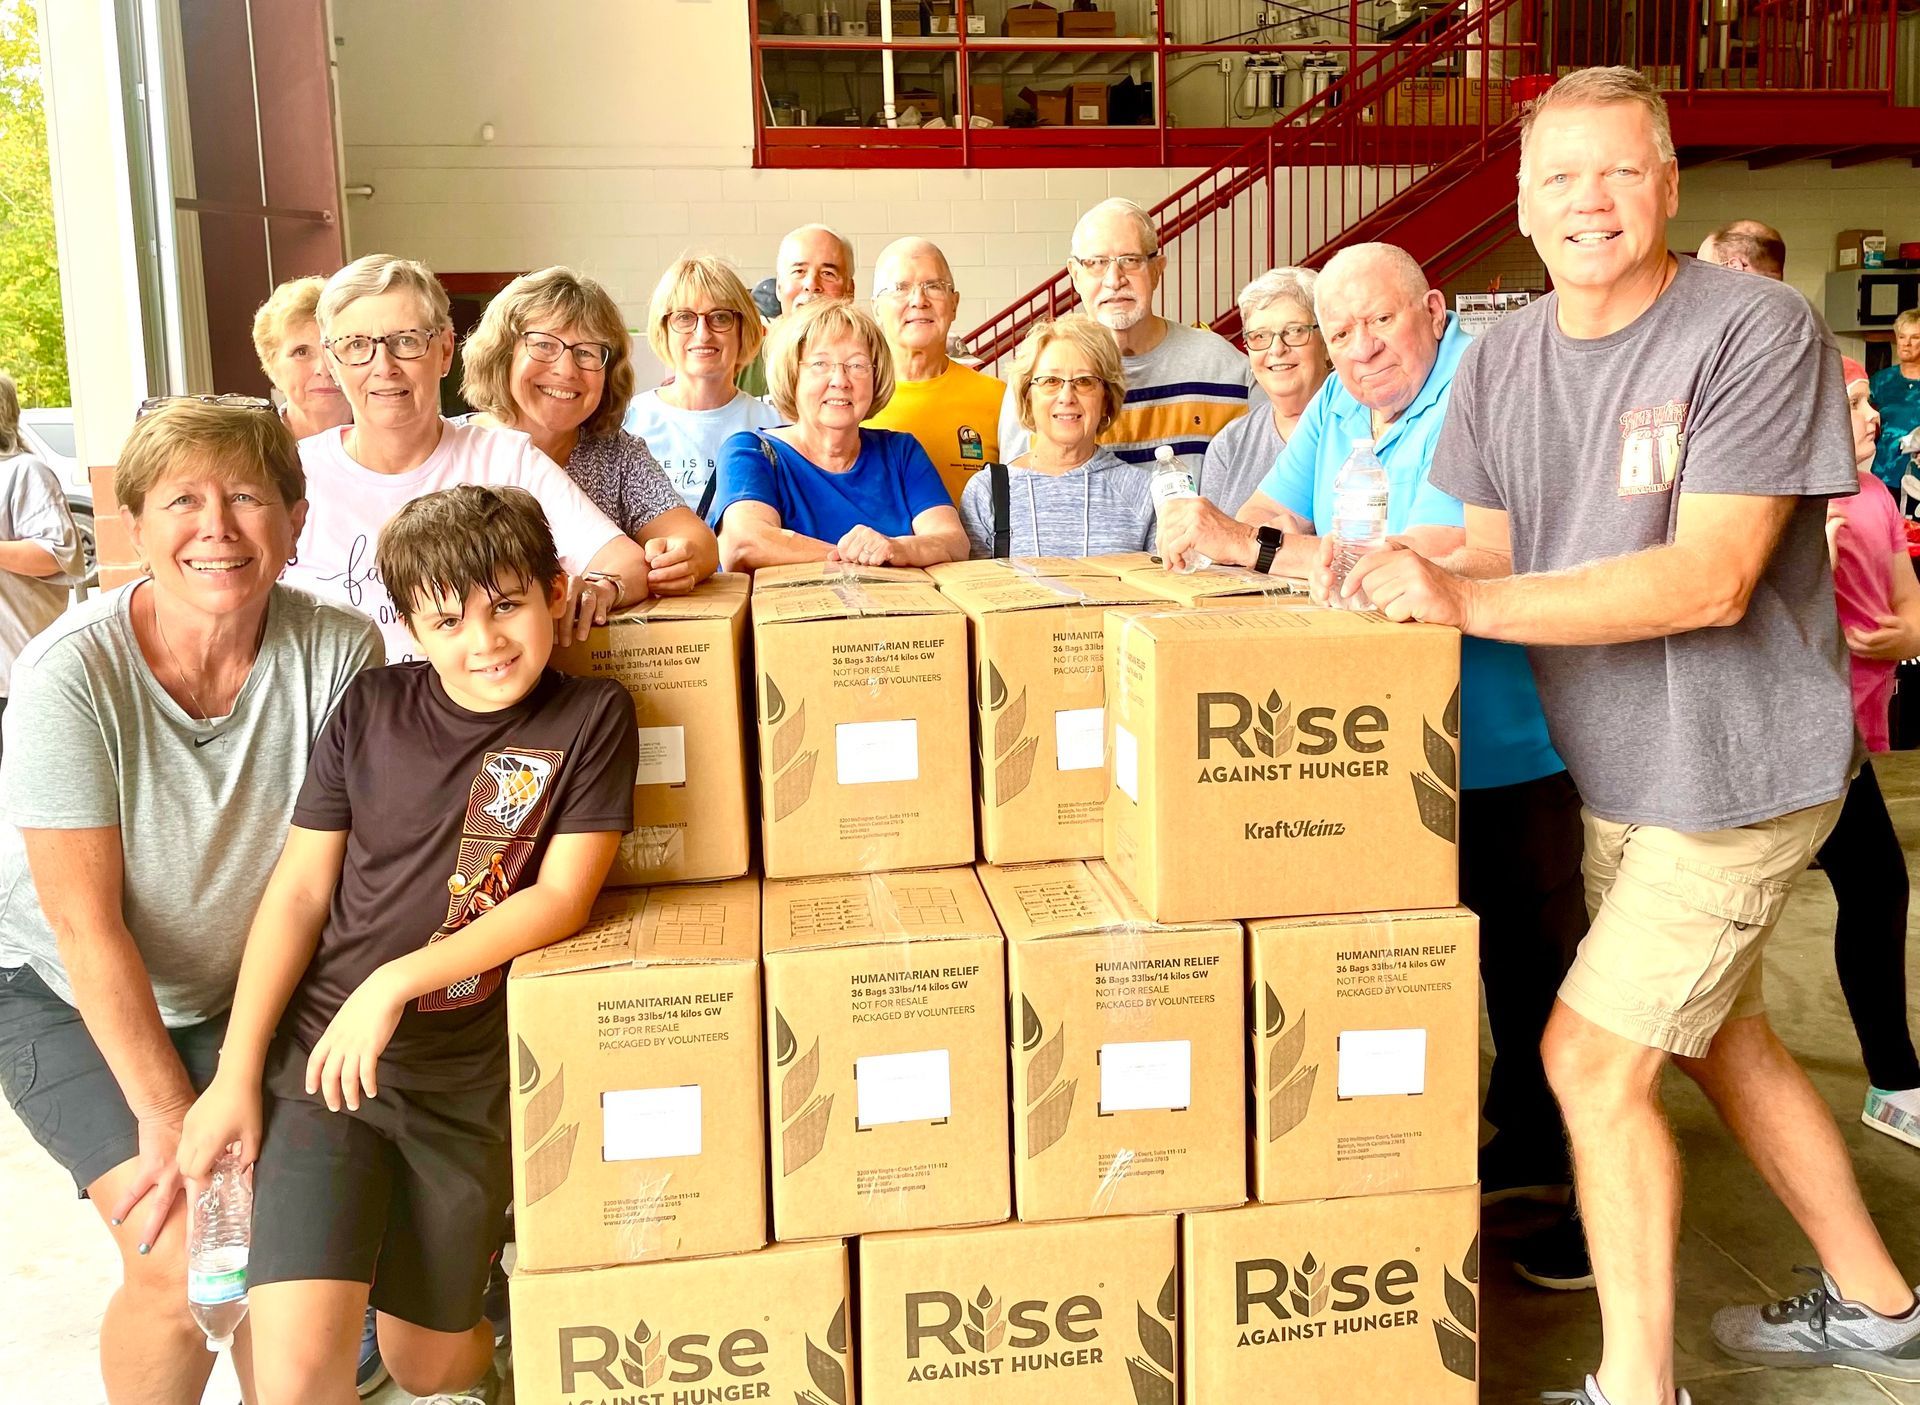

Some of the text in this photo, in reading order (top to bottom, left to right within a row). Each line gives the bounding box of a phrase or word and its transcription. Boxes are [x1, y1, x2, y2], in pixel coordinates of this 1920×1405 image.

[682, 459, 696, 468] IS
[1053, 631, 1104, 641] HUMANITA
[676, 644, 710, 653] RELIEF
[833, 640, 944, 653] HUMANITARIAN RELIEF
[627, 660, 662, 669] 33lbs/14
[664, 658, 682, 666] kilos
[866, 654, 898, 663] 33lbs/14
[634, 671, 664, 679] RESALE
[1054, 666, 1095, 674] PACKAGED
[654, 679, 707, 690] VOLUNTEERS
[890, 674, 941, 684] VOLUNTEERS
[1198, 688, 1389, 759] Rise
[1198, 760, 1389, 783] AGAINST HUNGER
[1244, 819, 1345, 840] KraftHeinz
[1337, 945, 1456, 960] HUMANITARIAN RELIEF
[1096, 956, 1219, 972] HUMANITARIAN RELIEF
[1350, 965, 1369, 973] Bags
[1372, 962, 1406, 970] 33lbs/14
[852, 966, 979, 984] HUMANITARIAN RELIEF
[1109, 977, 1129, 985] Bags
[1132, 974, 1168, 982] 33lbs/14
[1337, 977, 1356, 985] NOT
[1378, 973, 1407, 982] RESALE
[889, 985, 926, 994] 33lbs/14
[929, 983, 949, 991] kilos
[952, 981, 968, 989] GW
[1096, 989, 1115, 997] NOT
[1138, 985, 1169, 994] RESALE
[1337, 988, 1382, 997] PACKAGED
[1397, 982, 1452, 993] VOLUNTEERS
[598, 992, 733, 1011] HUMANITARIAN RELIEF
[852, 1001, 872, 1010] NOT
[896, 997, 928, 1006] RESALE
[1096, 1000, 1143, 1010] PACKAGED
[1159, 995, 1214, 1005] VOLUNTEERS
[613, 1015, 635, 1024] Bags
[638, 1011, 678, 1020] 33lbs/14
[681, 1009, 701, 1018] kilos
[705, 1008, 721, 1016] GW
[853, 1005, 975, 1023] PACKAGED BY VOLUNTEERS
[599, 1023, 679, 1036] NOT FOR RESALE
[600, 1032, 729, 1050] PACKAGED BY VOLUNTEERS
[1236, 1251, 1418, 1325] Rise
[906, 1284, 1102, 1359] Rise
[1237, 1310, 1418, 1347] AGAINST HUNGER
[559, 1319, 769, 1394] Rise
[908, 1348, 1103, 1382] AGAINST HUNGER
[673, 1382, 770, 1405] HUNGER
